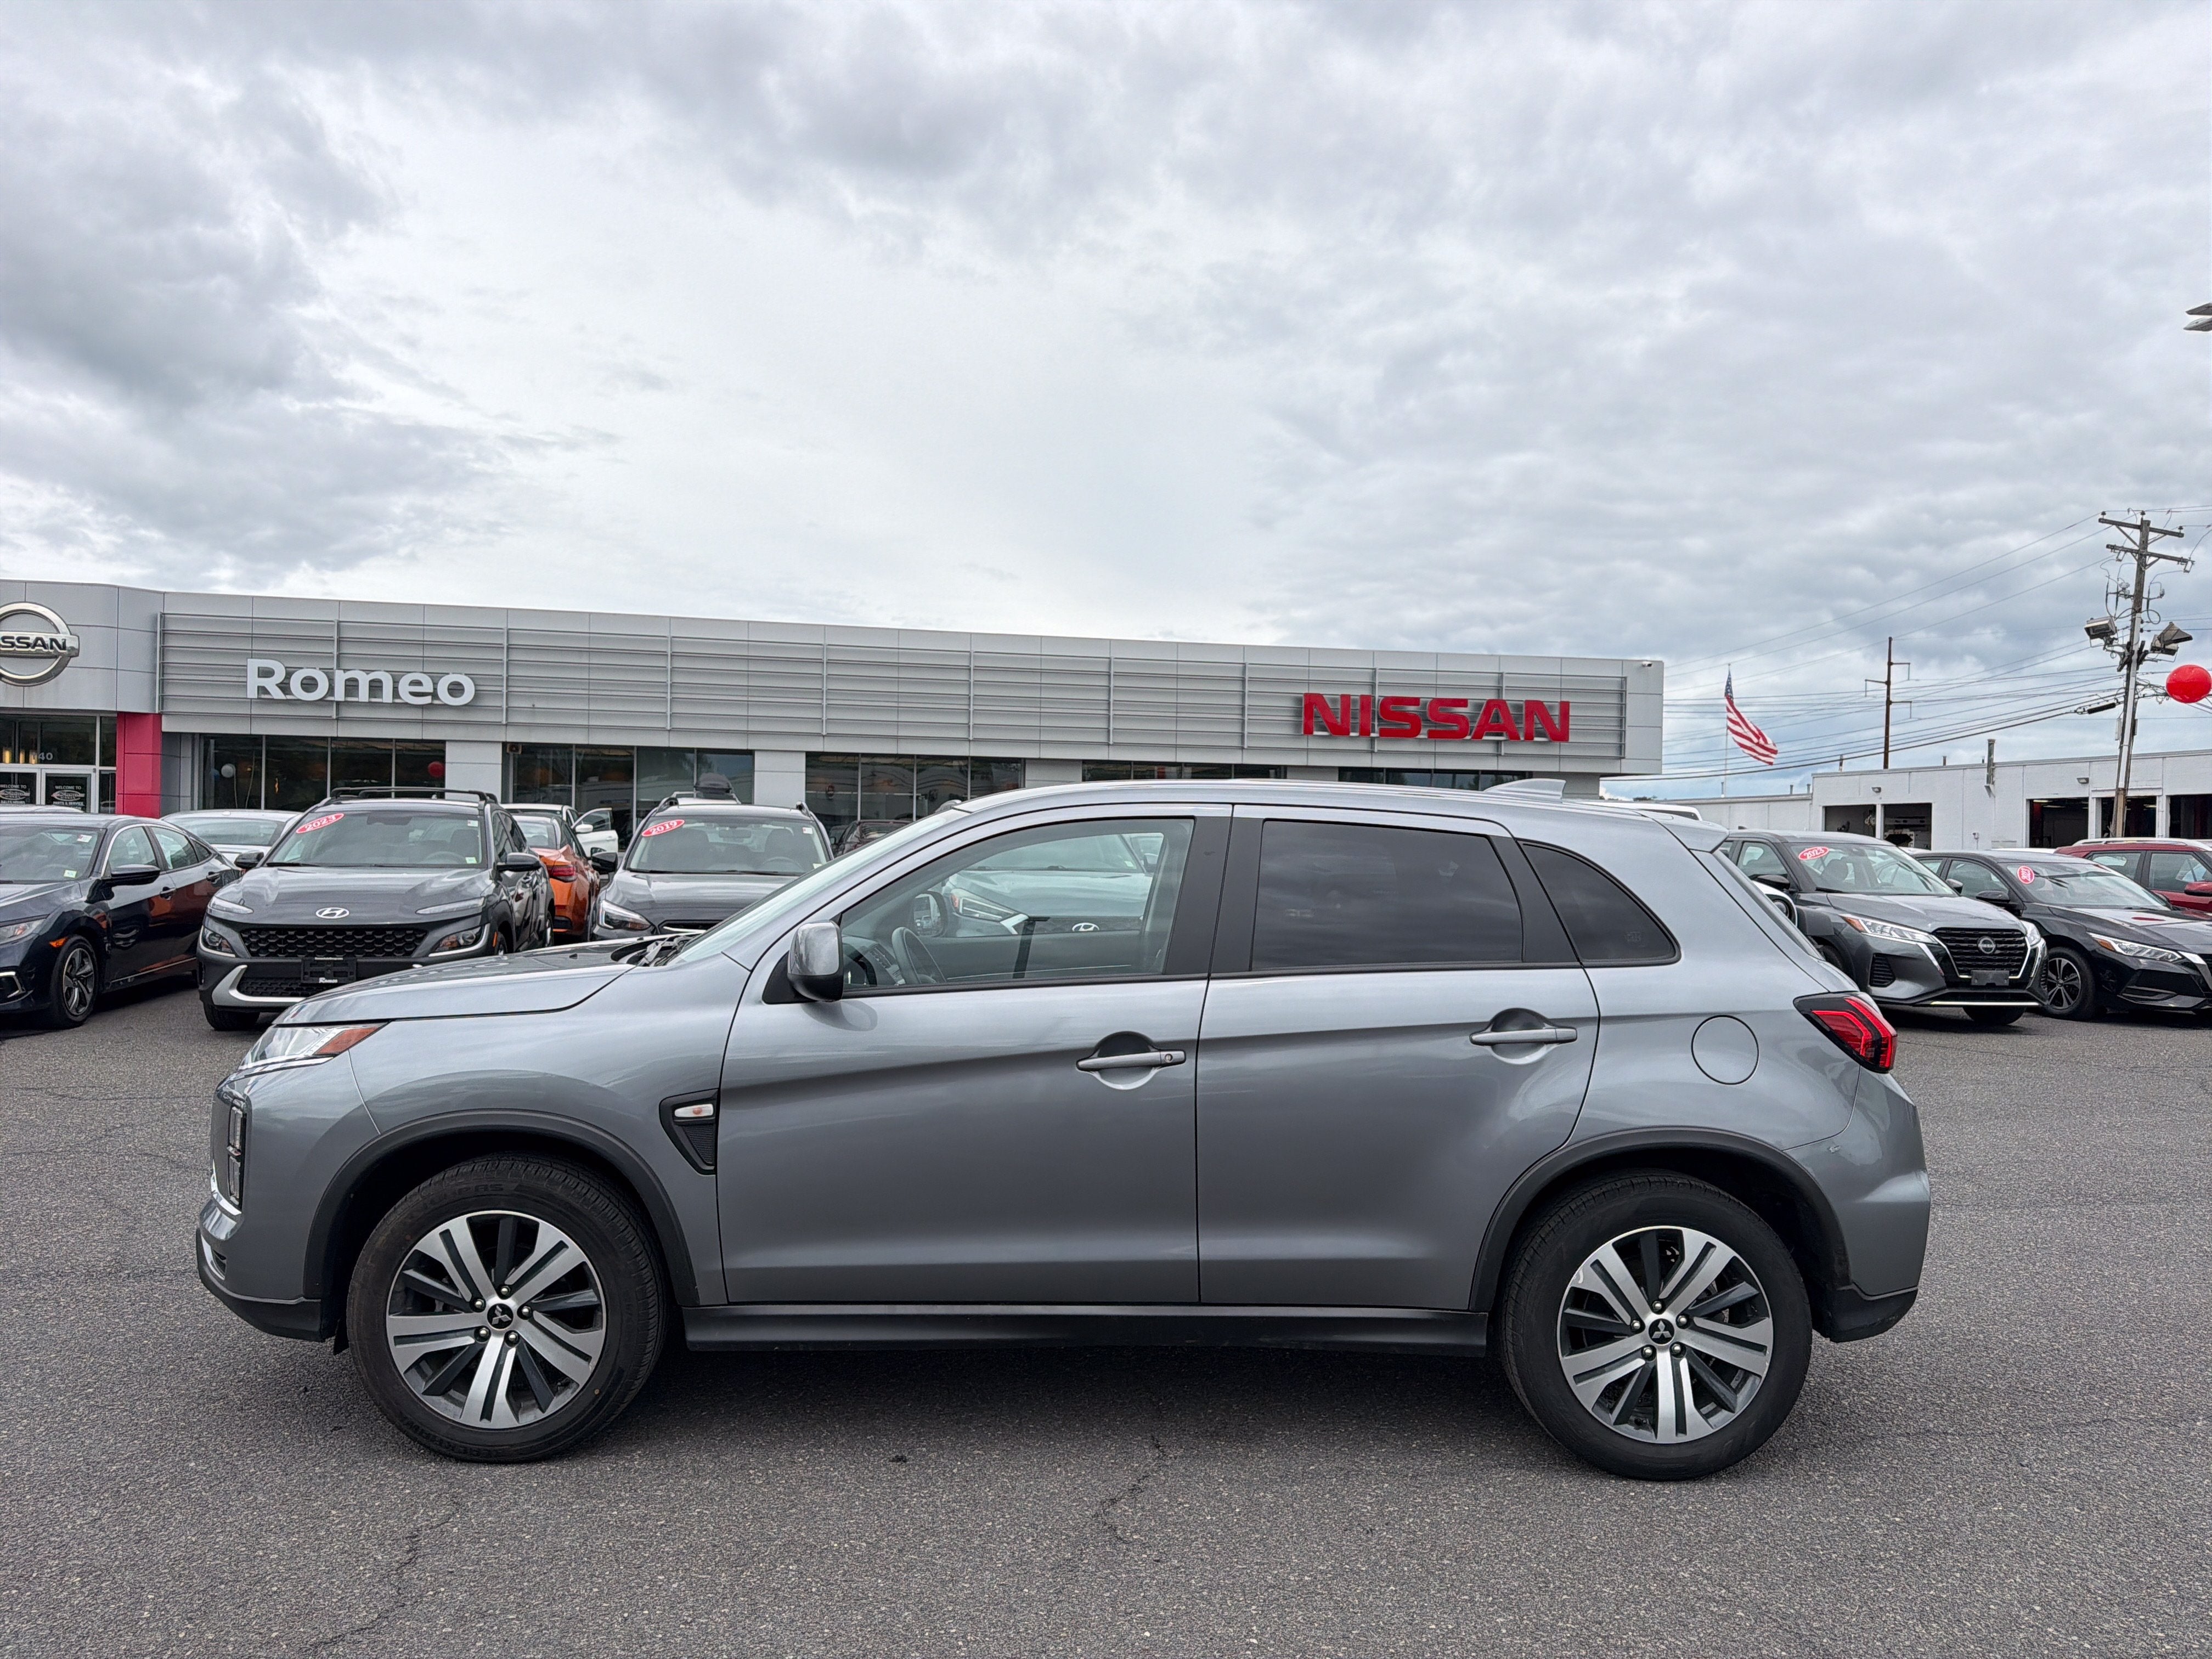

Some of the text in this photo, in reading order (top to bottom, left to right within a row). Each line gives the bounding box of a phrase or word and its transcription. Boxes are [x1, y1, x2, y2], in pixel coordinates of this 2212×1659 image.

[0, 635, 67, 651] SSAN
[247, 658, 475, 706] Romeo
[1303, 693, 1570, 742] NISSAN
[651, 820, 678, 834] 2019
